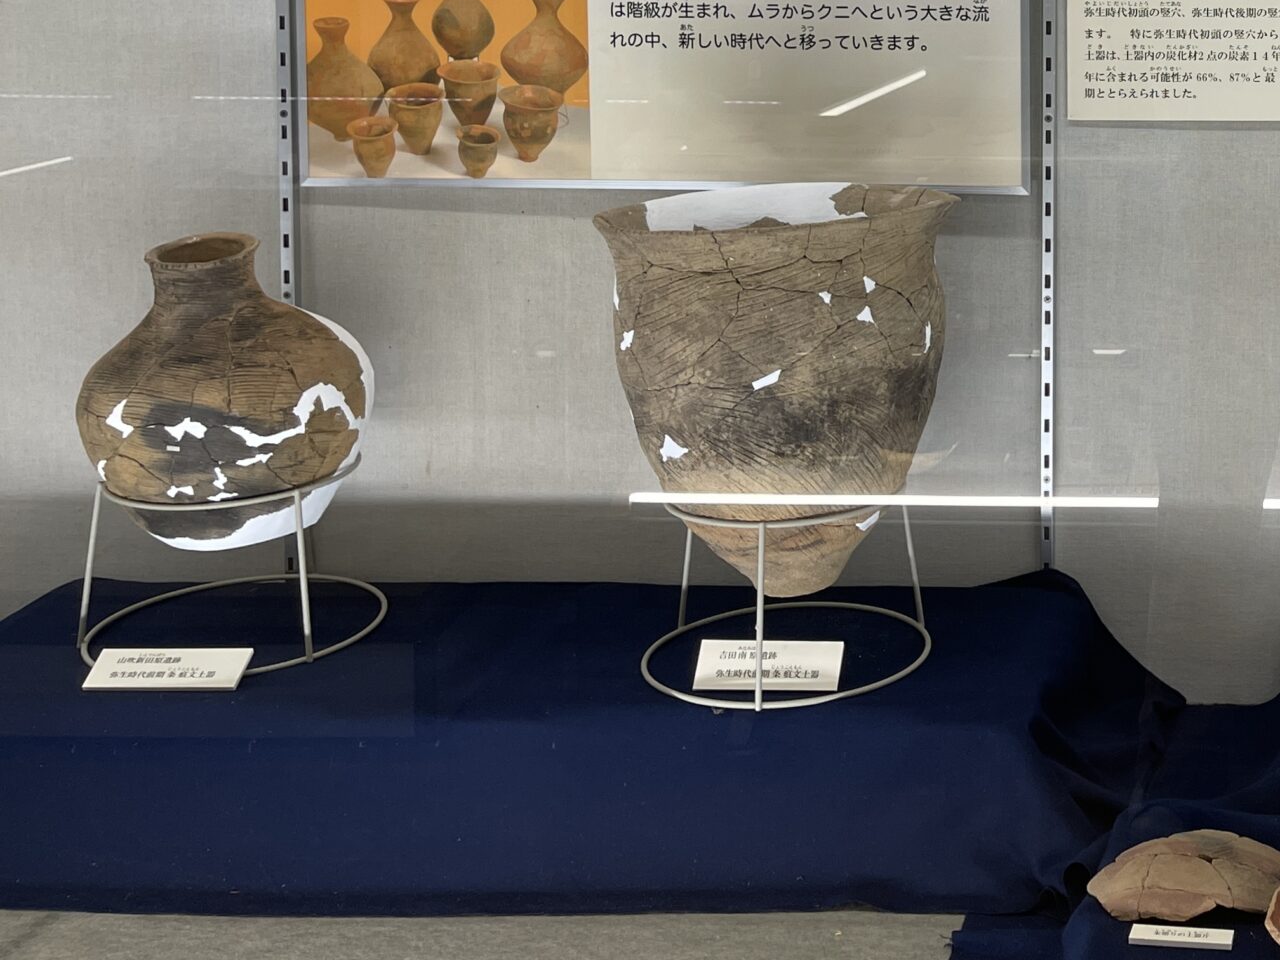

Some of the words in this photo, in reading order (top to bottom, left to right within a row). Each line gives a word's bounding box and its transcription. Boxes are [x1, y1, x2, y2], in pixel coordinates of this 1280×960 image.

[610, 32, 930, 51] れの中、新しい時代へと移っていきます。
[1085, 88, 1198, 99] 期ととらえられました。
